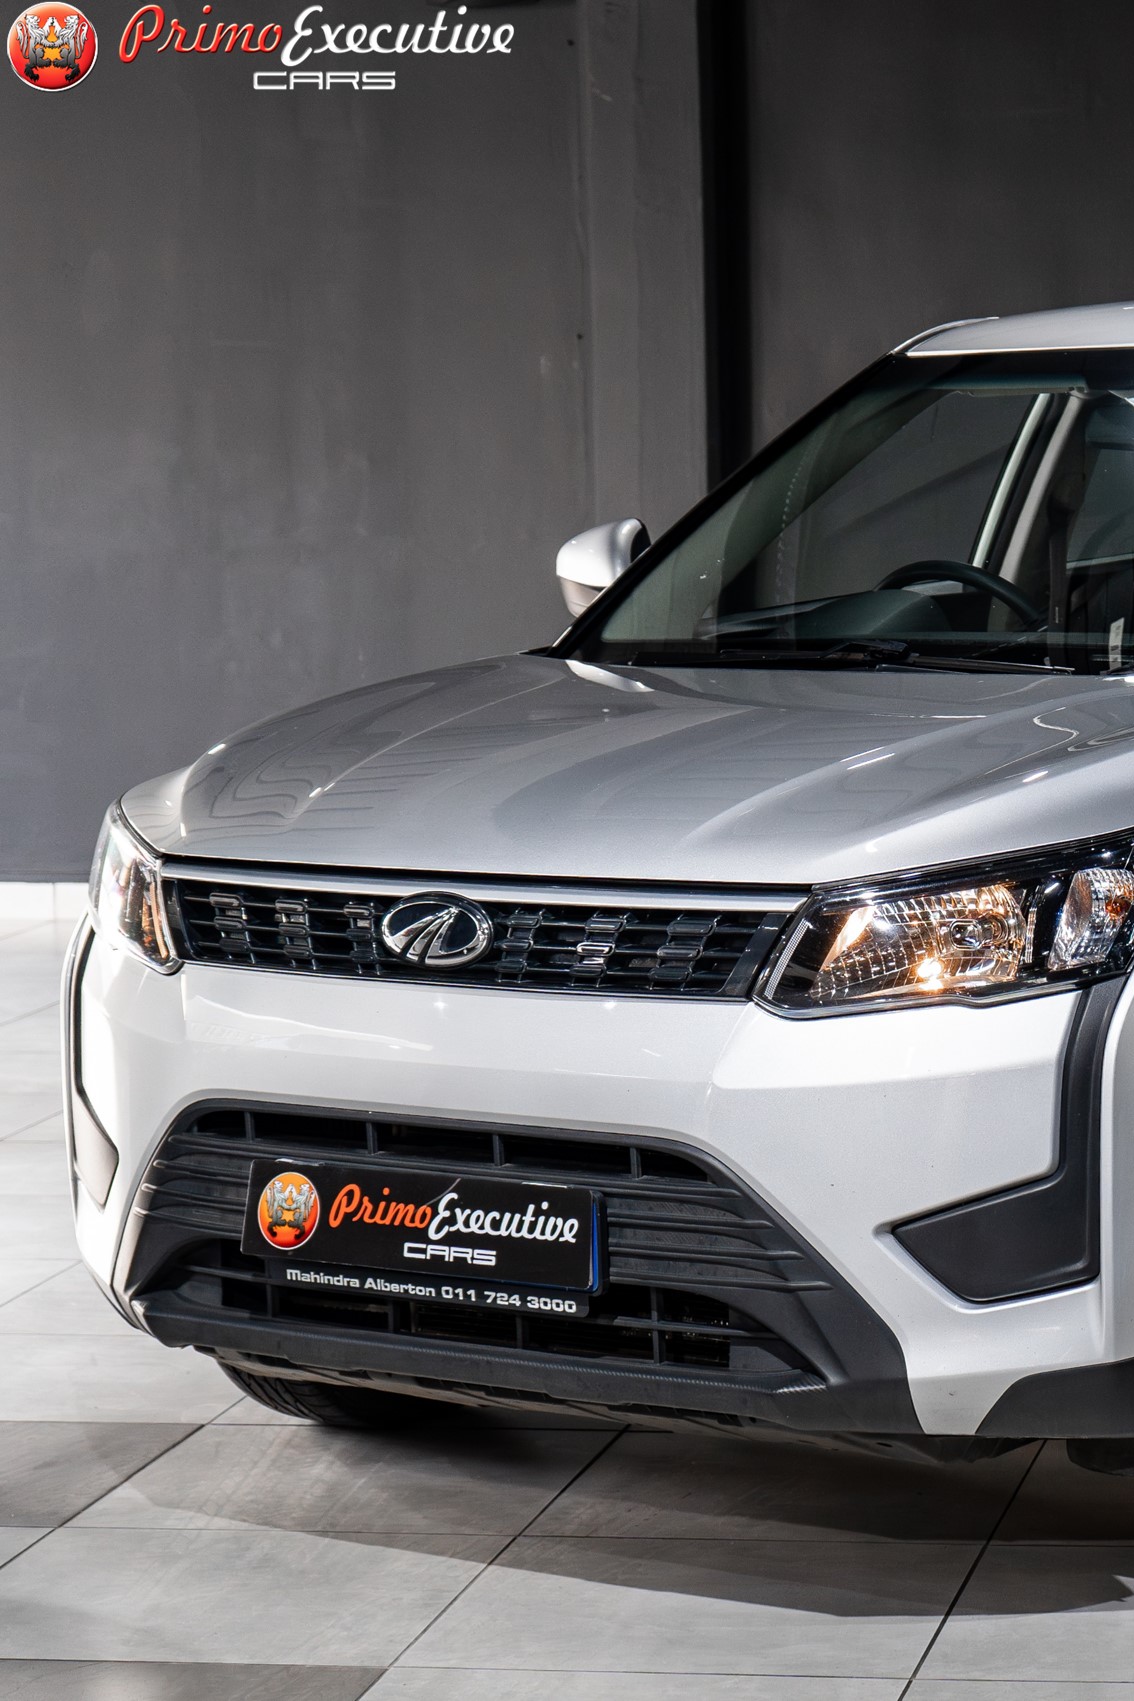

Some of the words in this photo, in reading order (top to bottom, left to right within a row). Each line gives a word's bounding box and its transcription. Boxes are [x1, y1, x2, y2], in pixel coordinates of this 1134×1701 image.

[328, 1183, 432, 1228] Primo
[429, 1192, 579, 1243] Executive
[403, 1242, 497, 1266] CARS
[286, 1268, 360, 1288] Mahindra
[364, 1277, 436, 1298] Alberton
[441, 1286, 476, 1302] 011
[484, 1291, 521, 1307] 724
[527, 1296, 577, 1313] 3000
